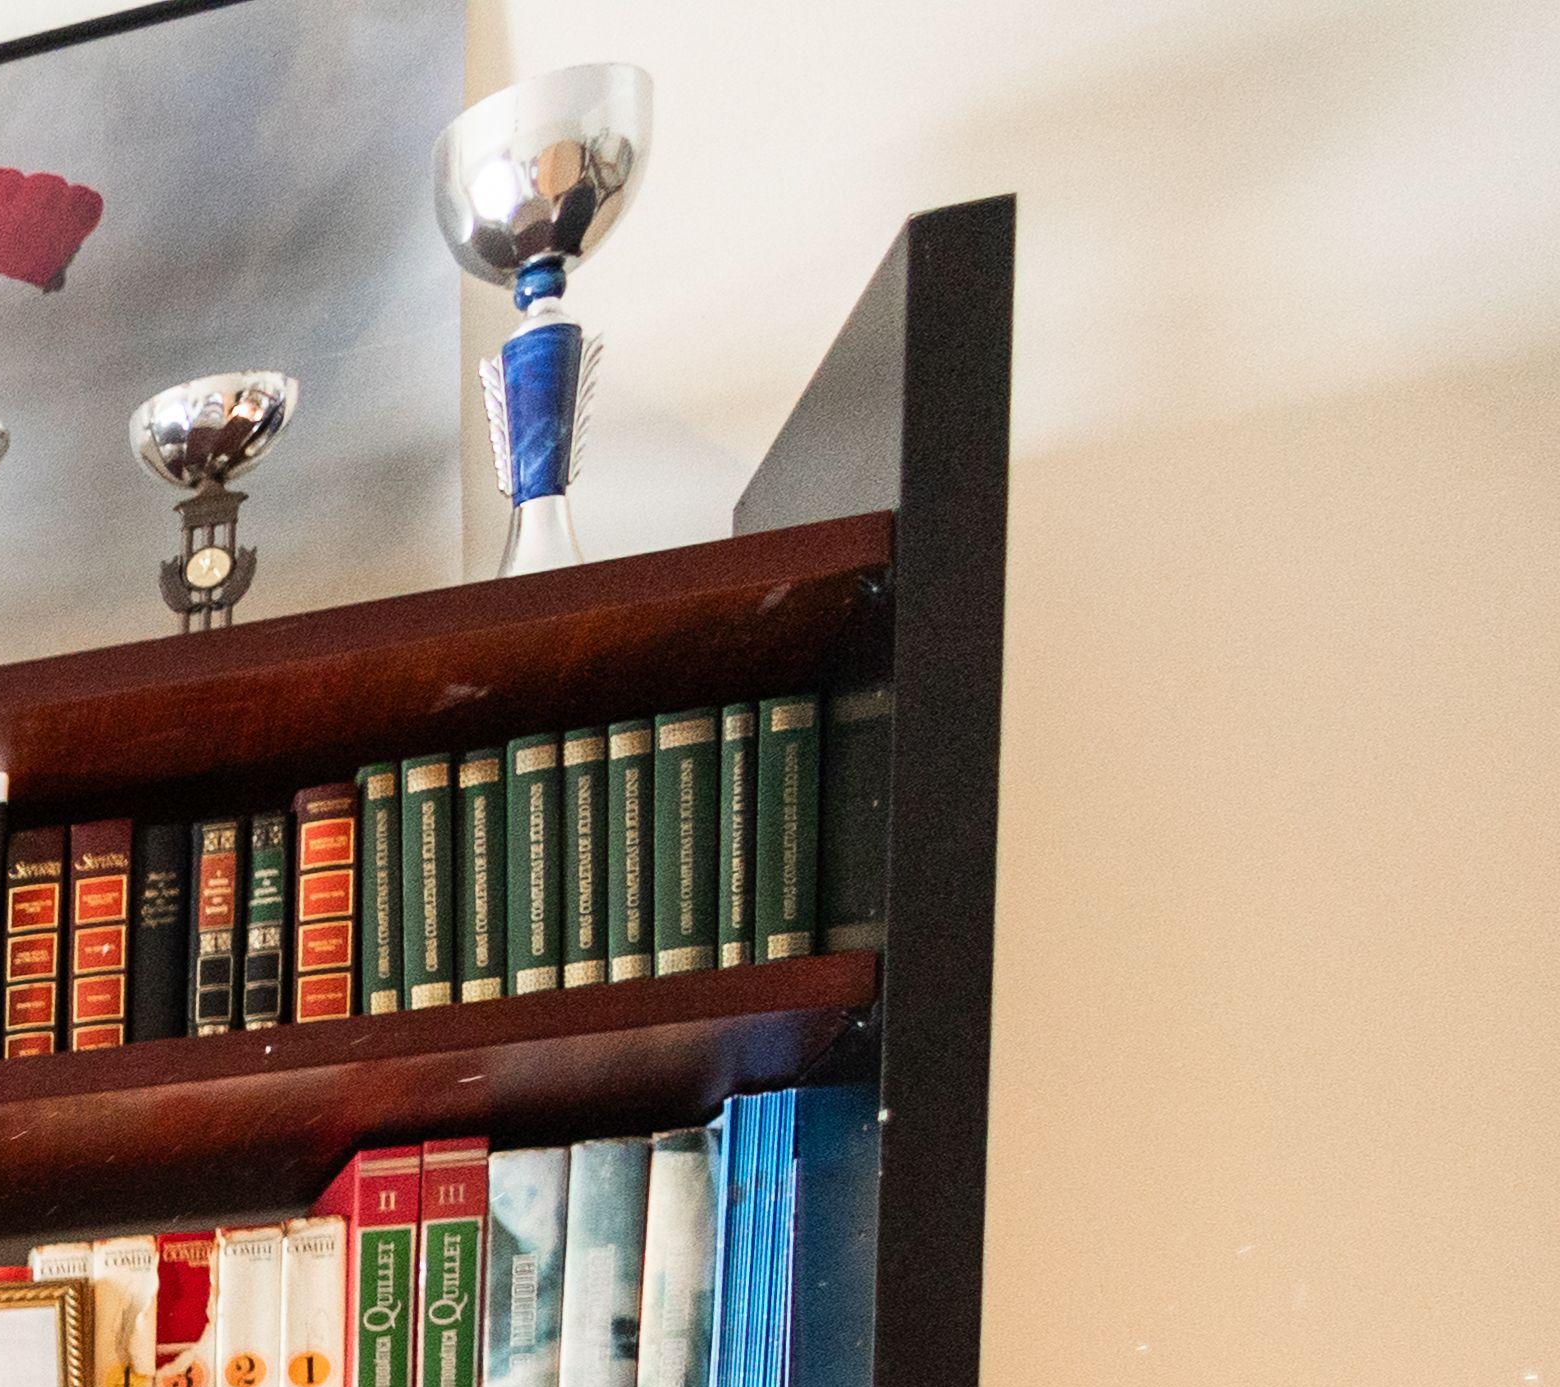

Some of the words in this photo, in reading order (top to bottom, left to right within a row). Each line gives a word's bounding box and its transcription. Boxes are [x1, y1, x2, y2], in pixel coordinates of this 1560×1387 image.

[380, 1191, 396, 1211] II
[438, 1184, 465, 1204] III
[236, 1356, 255, 1386] 2
[304, 1356, 315, 1385] 1
